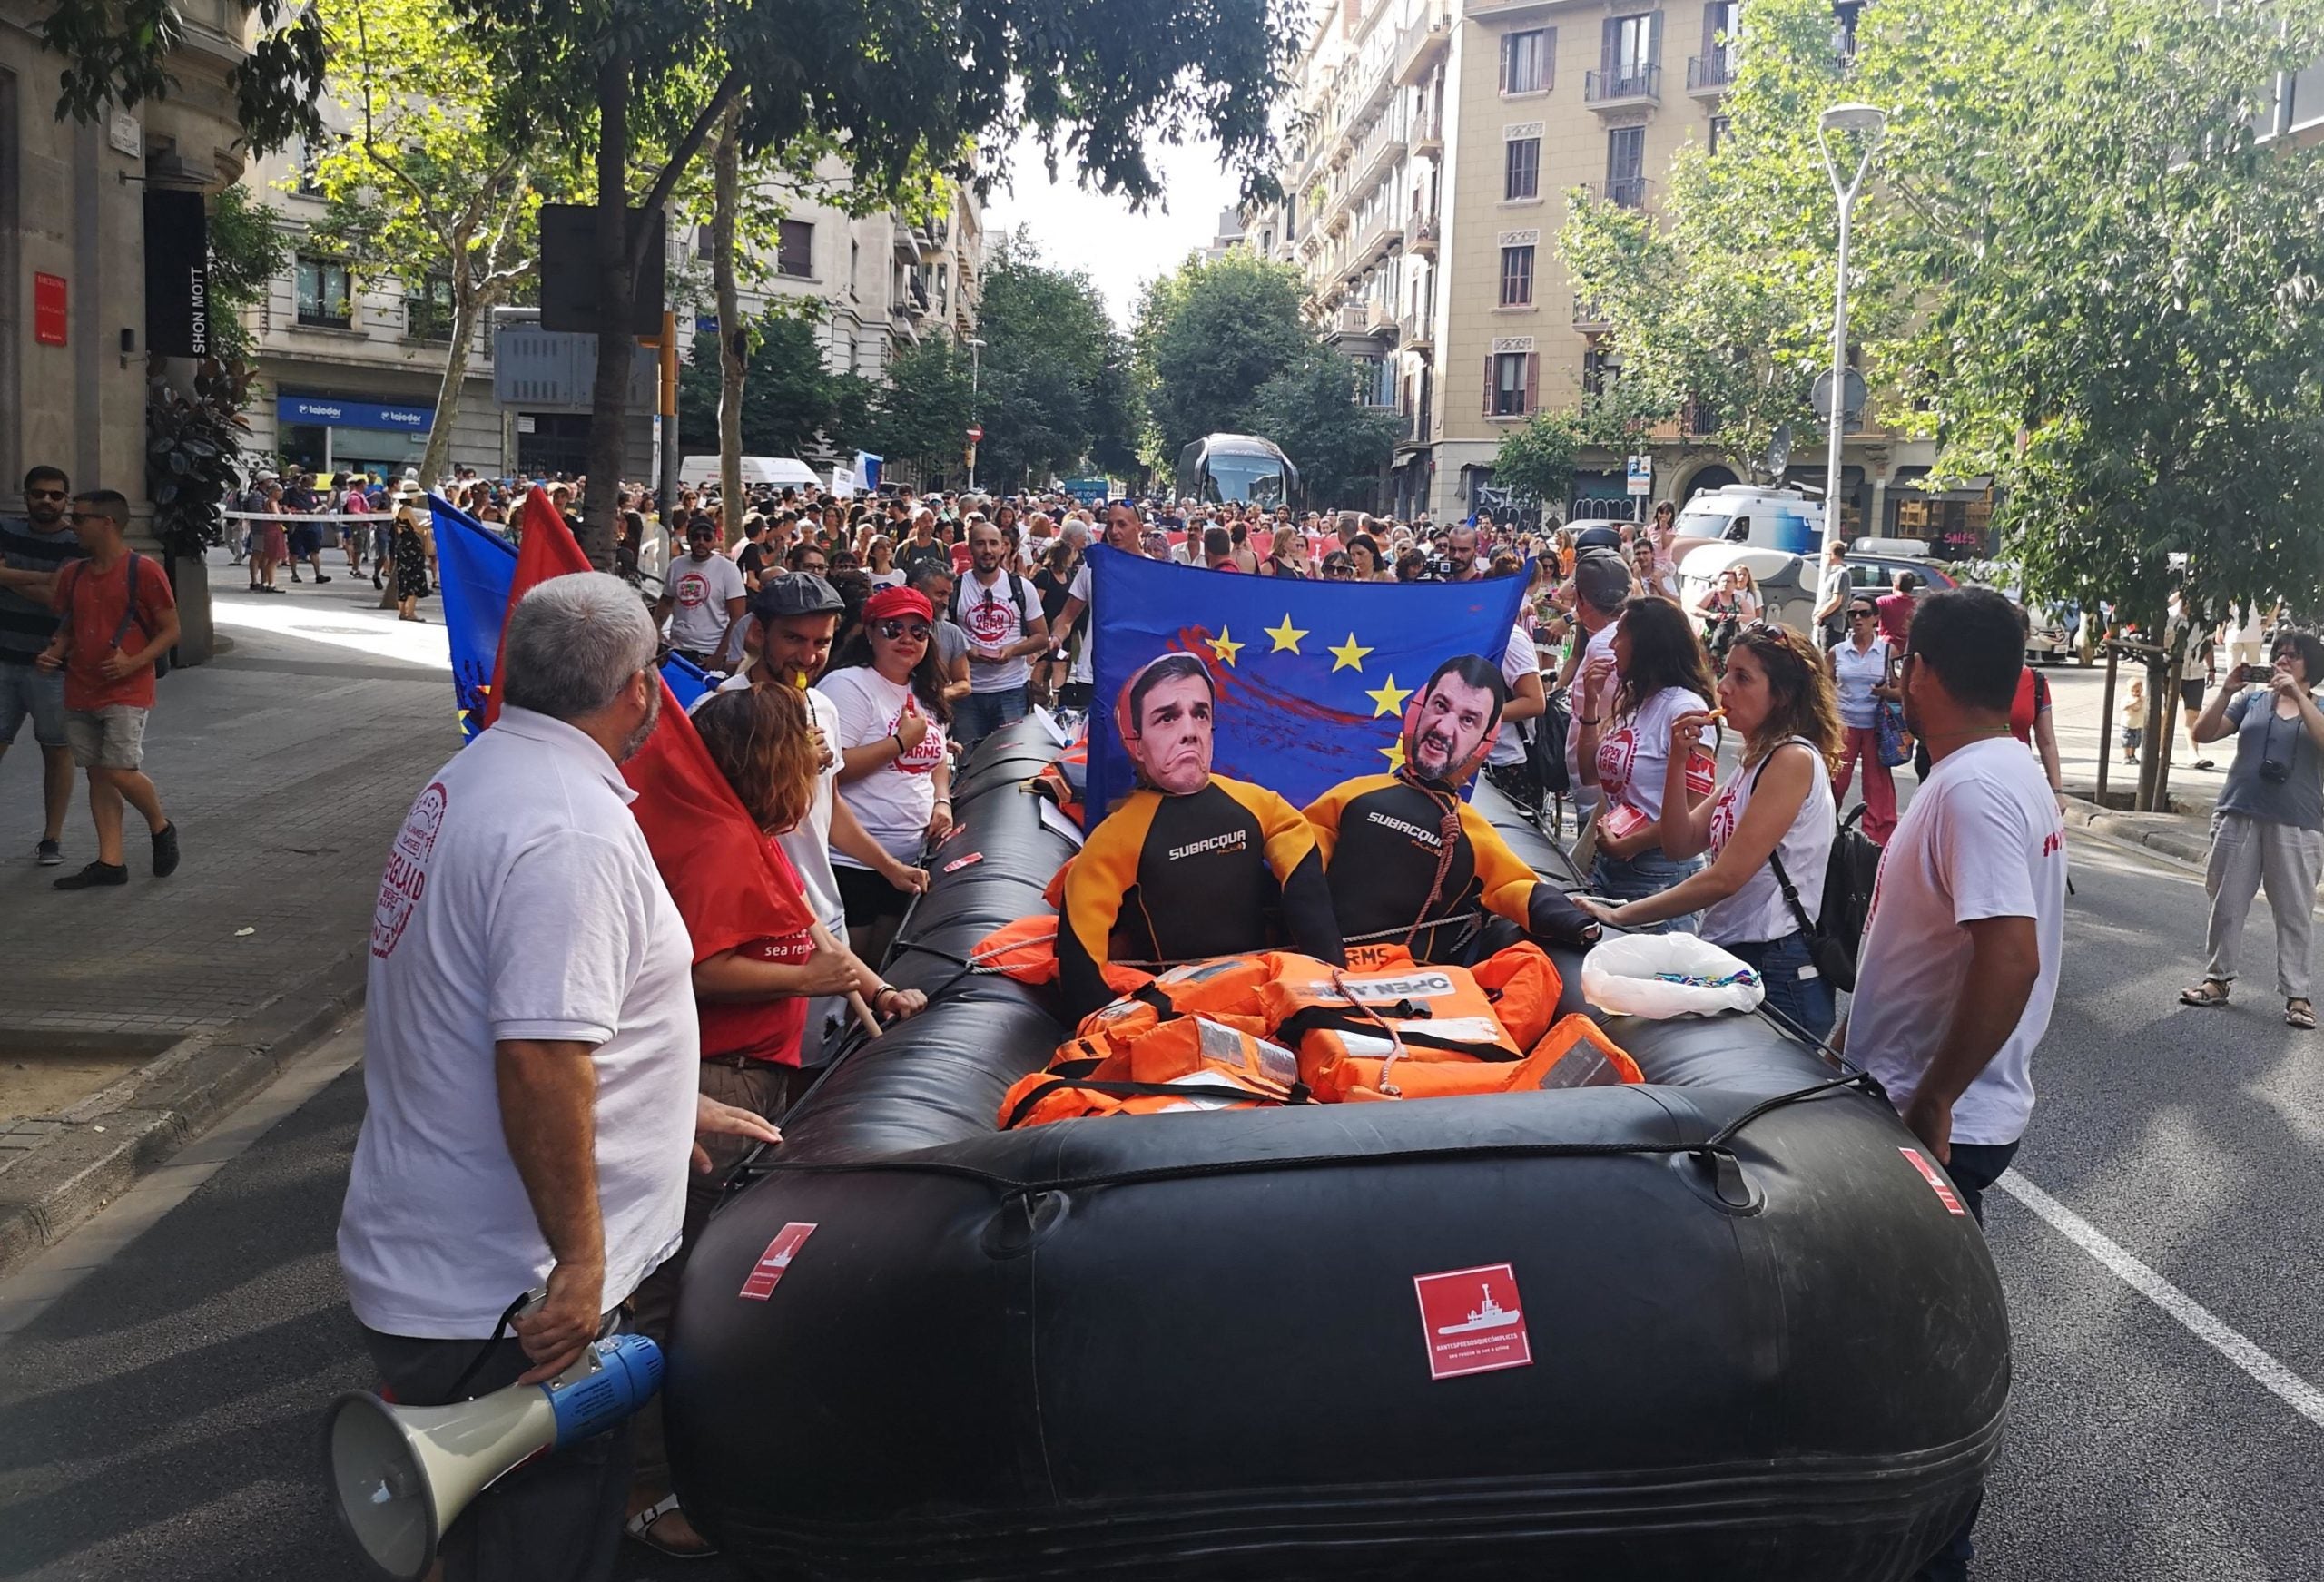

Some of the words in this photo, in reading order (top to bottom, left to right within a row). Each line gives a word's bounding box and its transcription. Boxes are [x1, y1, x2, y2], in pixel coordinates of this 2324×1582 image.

[191, 266, 204, 308] MOTT
[192, 312, 206, 354] SHON
[1943, 532, 1976, 545] SALES
[976, 614, 1004, 624] OPEN
[976, 622, 1004, 630] ARMS
[924, 732, 941, 745] EN
[904, 745, 941, 759] ARMS
[1600, 744, 1623, 762] OPEN
[1169, 830, 1246, 860] SUBACQUA
[764, 946, 788, 957] sea
[1345, 948, 1390, 966] RMS
